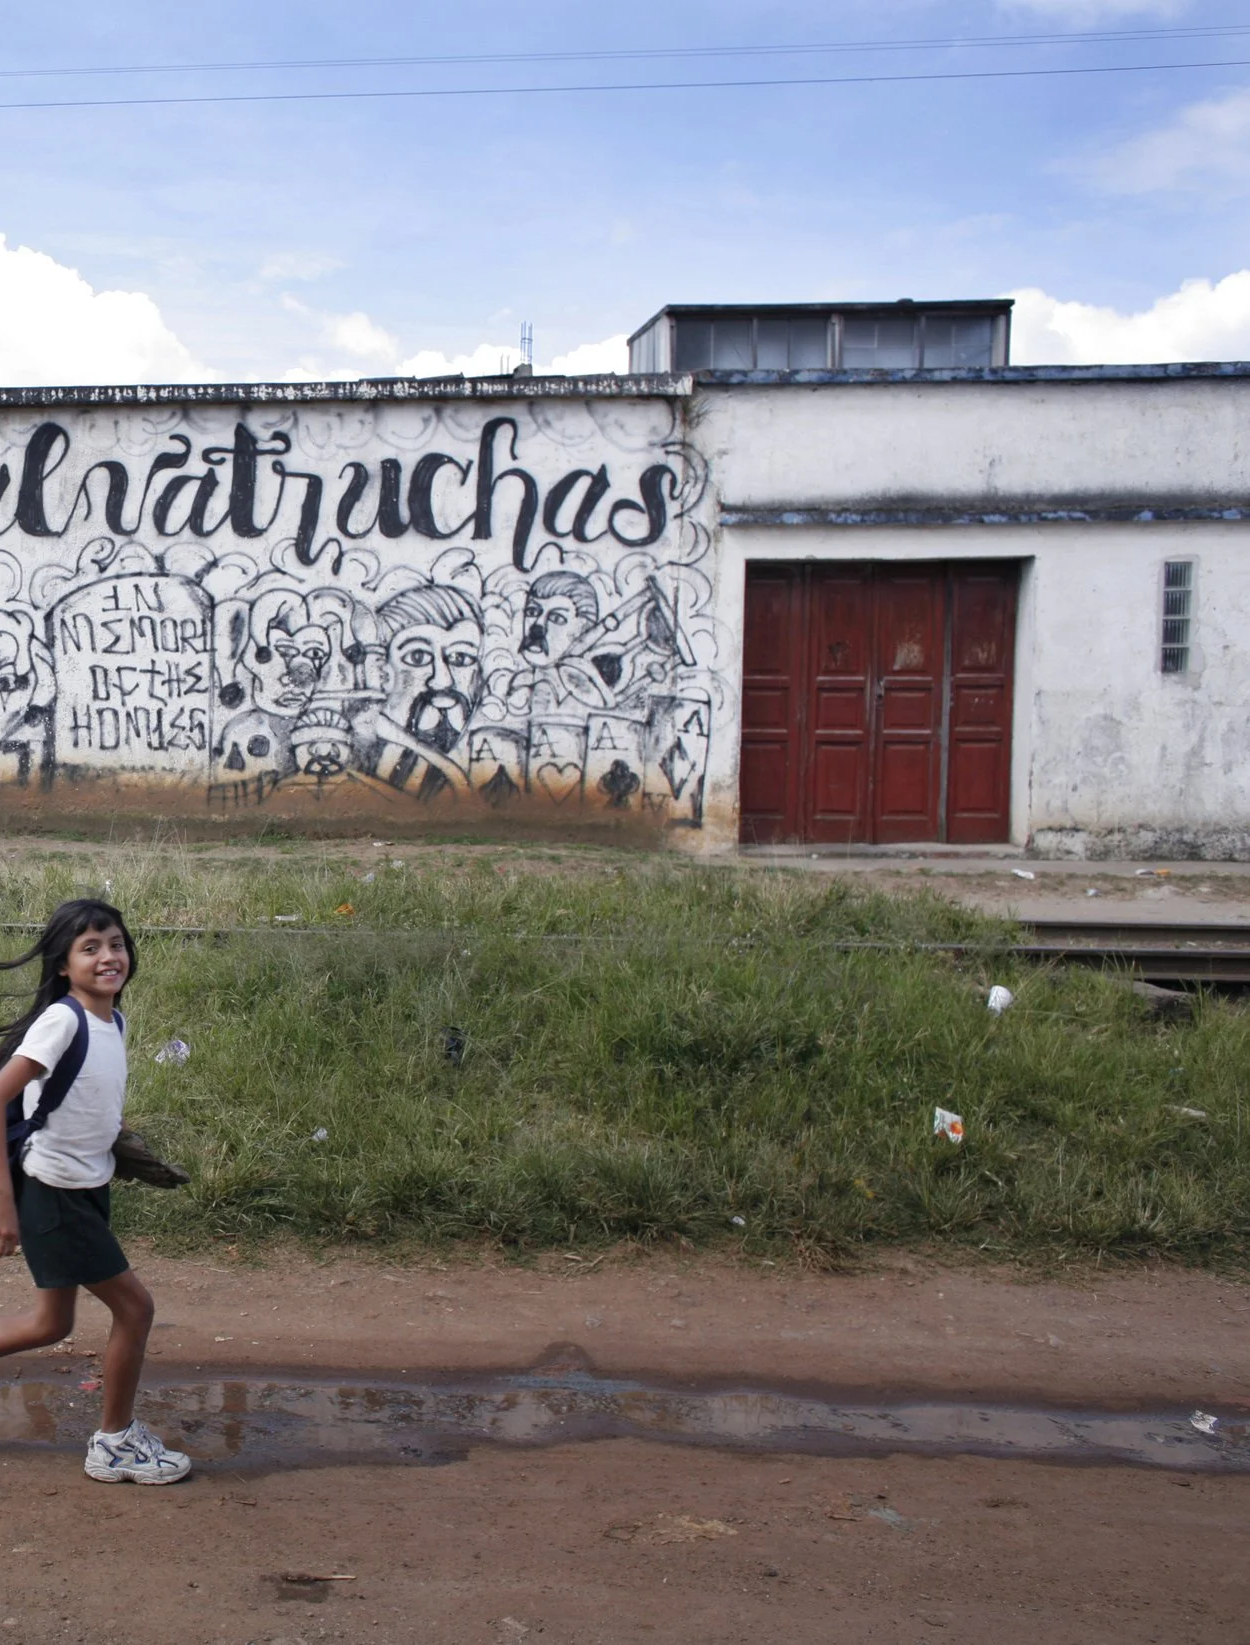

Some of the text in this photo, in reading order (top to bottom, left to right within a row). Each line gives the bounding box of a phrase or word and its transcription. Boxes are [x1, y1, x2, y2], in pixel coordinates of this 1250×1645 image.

[102, 582, 165, 613] IN
[470, 738, 501, 762] A
[531, 727, 561, 759] A
[591, 721, 628, 751] A
